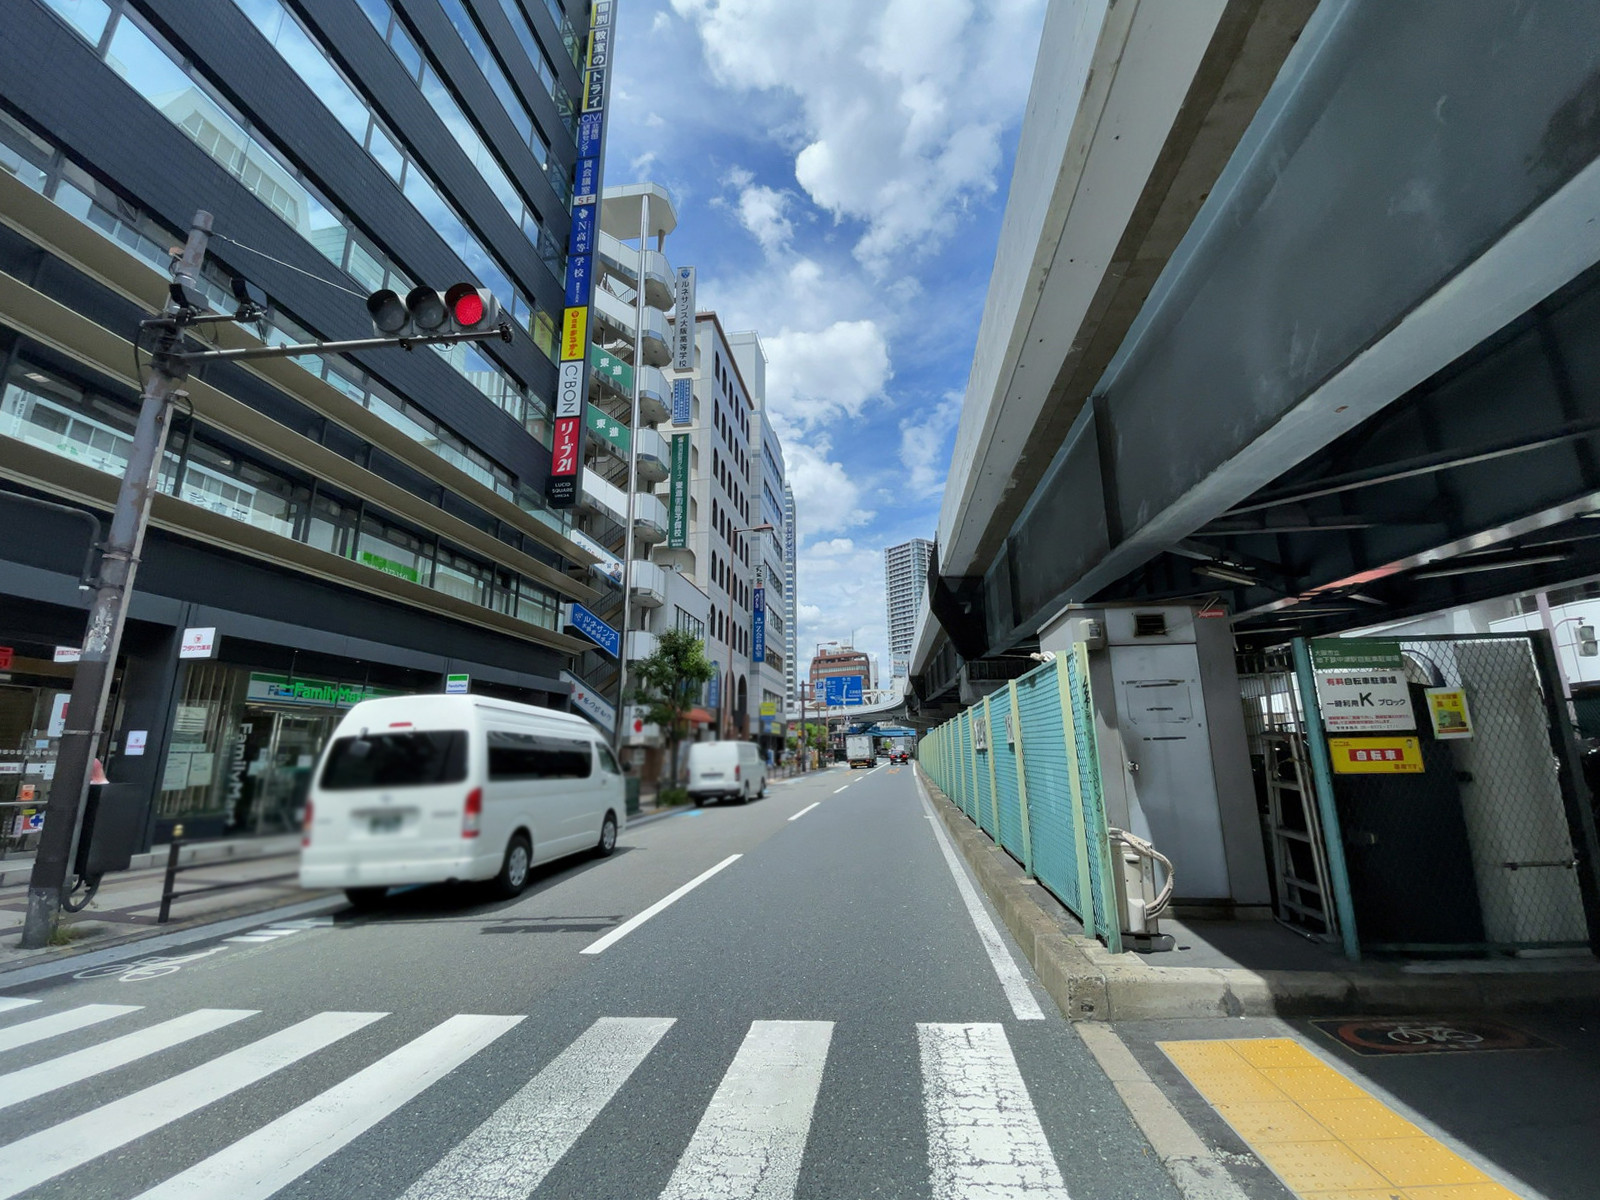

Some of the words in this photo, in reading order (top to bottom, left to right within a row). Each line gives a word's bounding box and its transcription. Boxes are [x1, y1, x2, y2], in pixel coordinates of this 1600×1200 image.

[590, 3, 609, 107] 個別教室のトライ
[582, 113, 601, 122] CIVI
[581, 160, 592, 194] 貸会議室
[679, 281, 689, 367] ルネサンス大阪高等学校
[600, 358, 622, 380] 東進
[596, 419, 619, 437] 東進
[584, 615, 616, 640] ルネサンス
[1327, 676, 1397, 685] 有料自転車駐車場
[1356, 750, 1396, 760] 自転車
